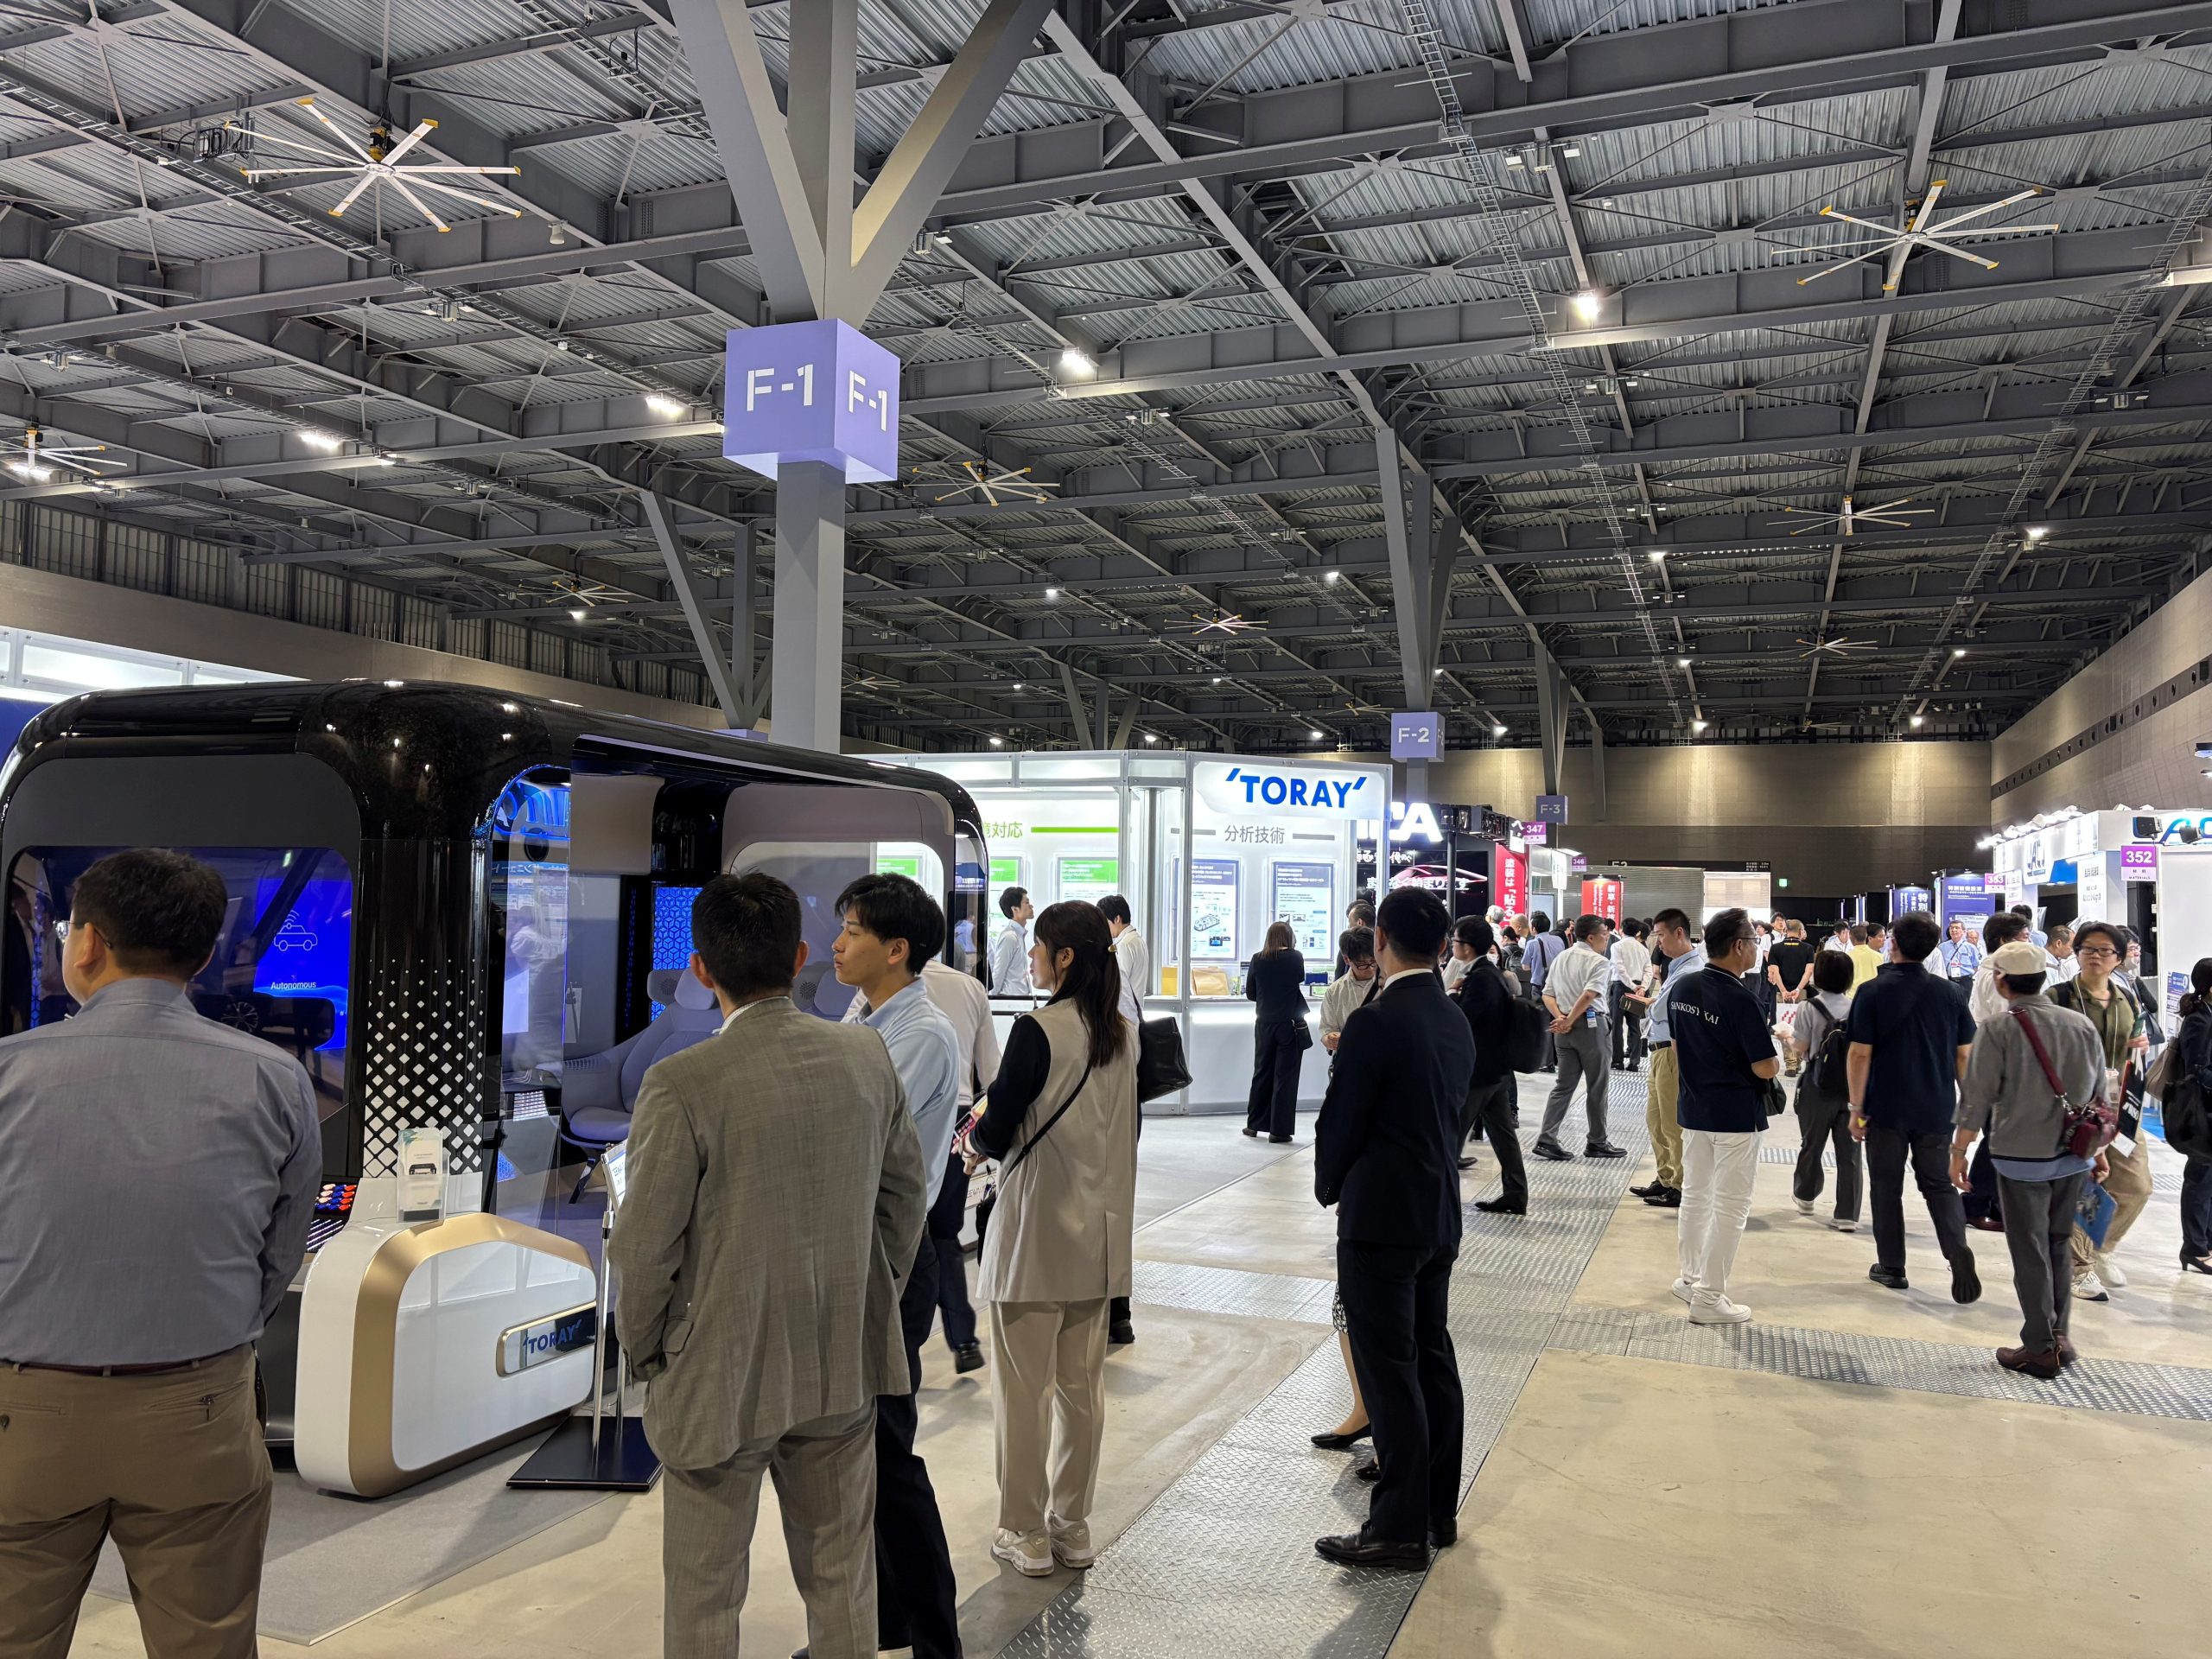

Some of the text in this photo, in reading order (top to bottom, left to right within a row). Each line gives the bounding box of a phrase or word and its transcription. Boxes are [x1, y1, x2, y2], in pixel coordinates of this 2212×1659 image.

[747, 364, 814, 412] F-1
[849, 370, 887, 431] F-1
[1398, 727, 1430, 743] F-2
[1541, 804, 1560, 814] F-3
[1224, 824, 1285, 844] 分析技術
[1526, 824, 1543, 834] 347
[2126, 850, 2152, 863] 352
[270, 982, 316, 990] Autonomous
